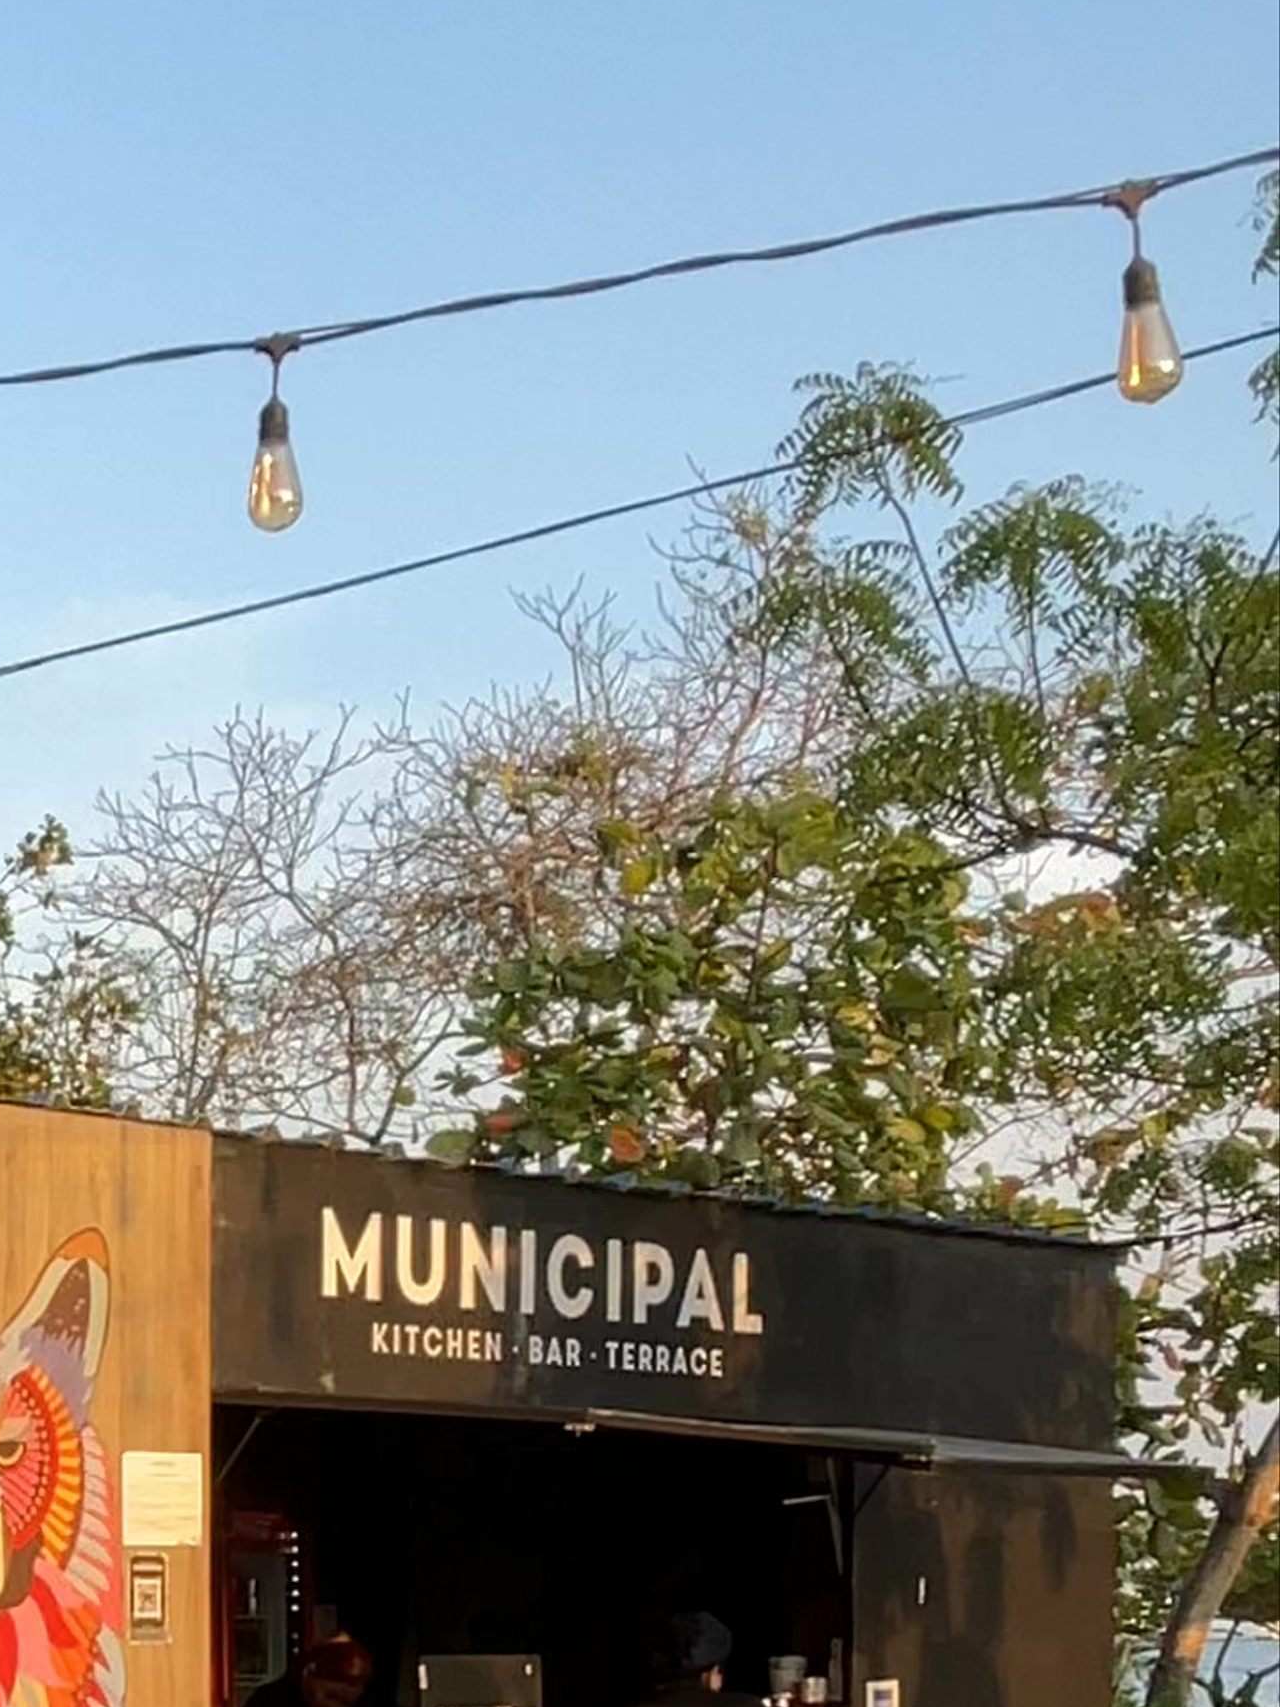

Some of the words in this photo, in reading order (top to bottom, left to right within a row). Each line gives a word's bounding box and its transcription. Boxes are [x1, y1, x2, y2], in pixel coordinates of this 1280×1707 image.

[321, 1207, 763, 1334] MUNICIPAL
[372, 1321, 502, 1361] KITCHEN
[528, 1334, 581, 1367] BAR
[606, 1340, 724, 1377] TERRACE
